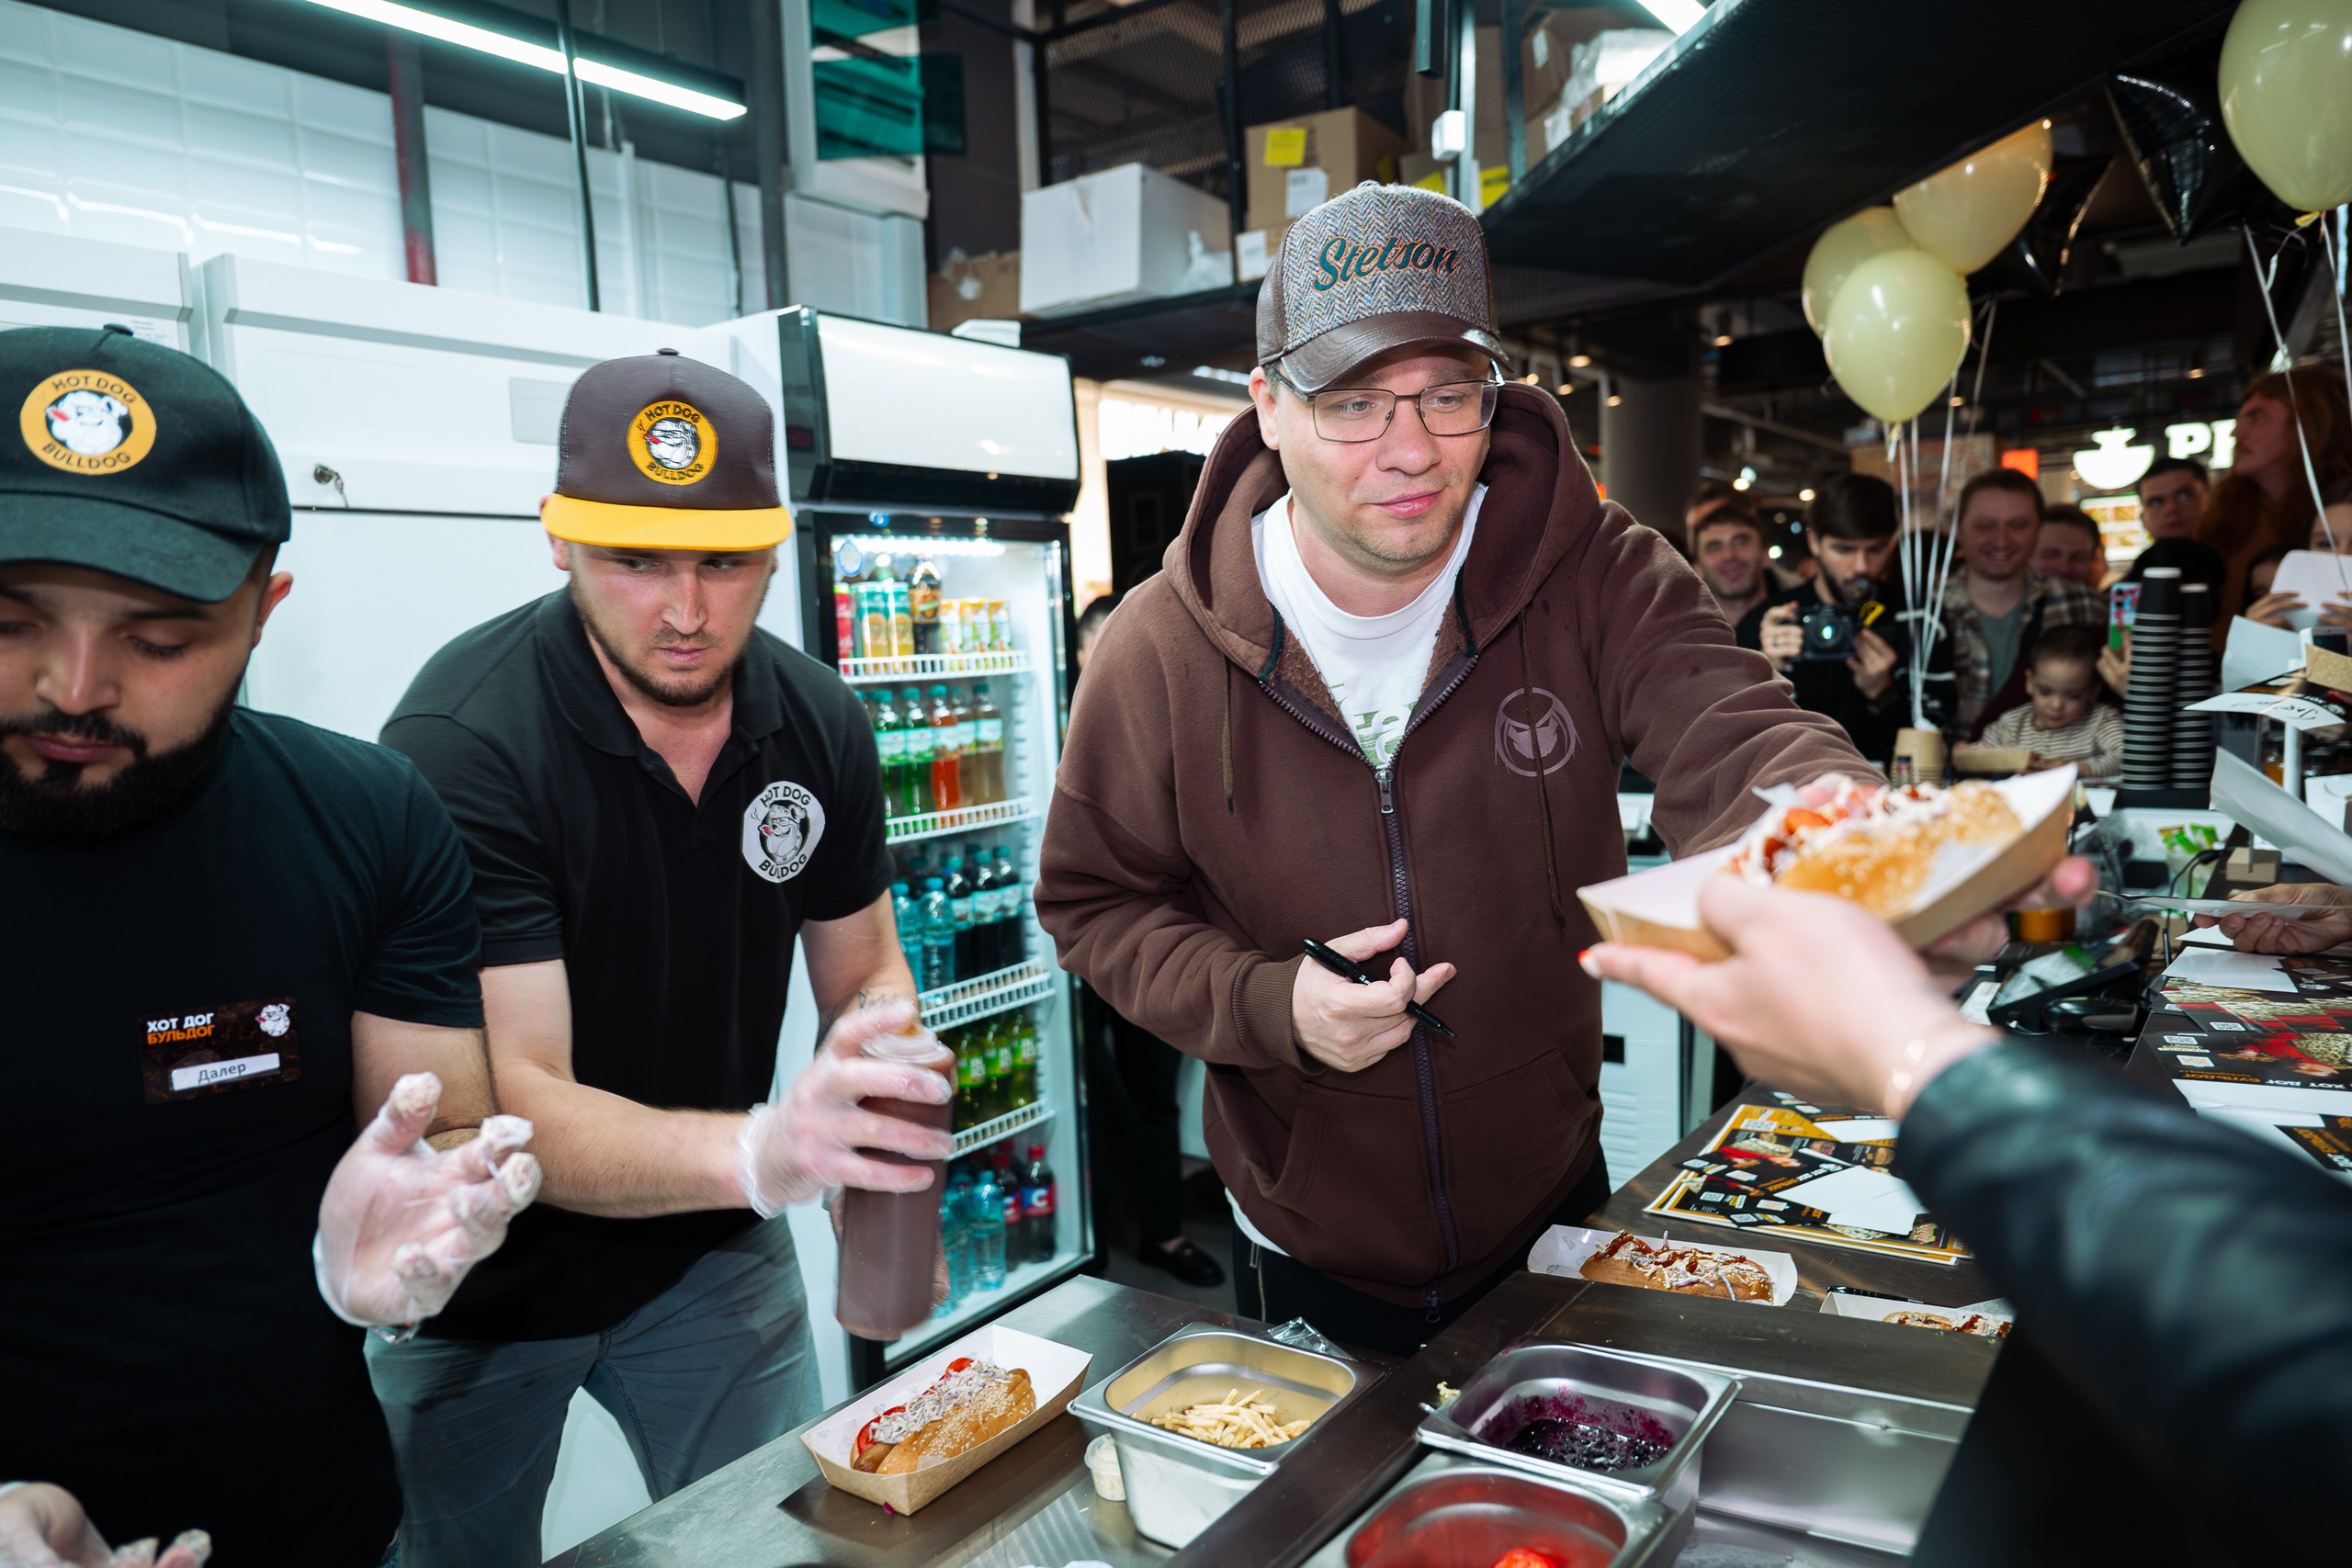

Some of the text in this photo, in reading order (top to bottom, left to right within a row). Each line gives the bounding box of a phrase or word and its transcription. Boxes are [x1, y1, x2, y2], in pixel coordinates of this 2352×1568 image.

[1312, 235, 1459, 294] Stetson
[52, 376, 137, 403] HOT DOG
[645, 404, 701, 423] HOT DOG
[42, 443, 130, 469] BULLDOG
[783, 786, 811, 806] DOG
[146, 1013, 215, 1033] ХОТ ДОГ
[147, 1024, 216, 1045] БУЛЬДОГ
[198, 1064, 246, 1085] Далер
